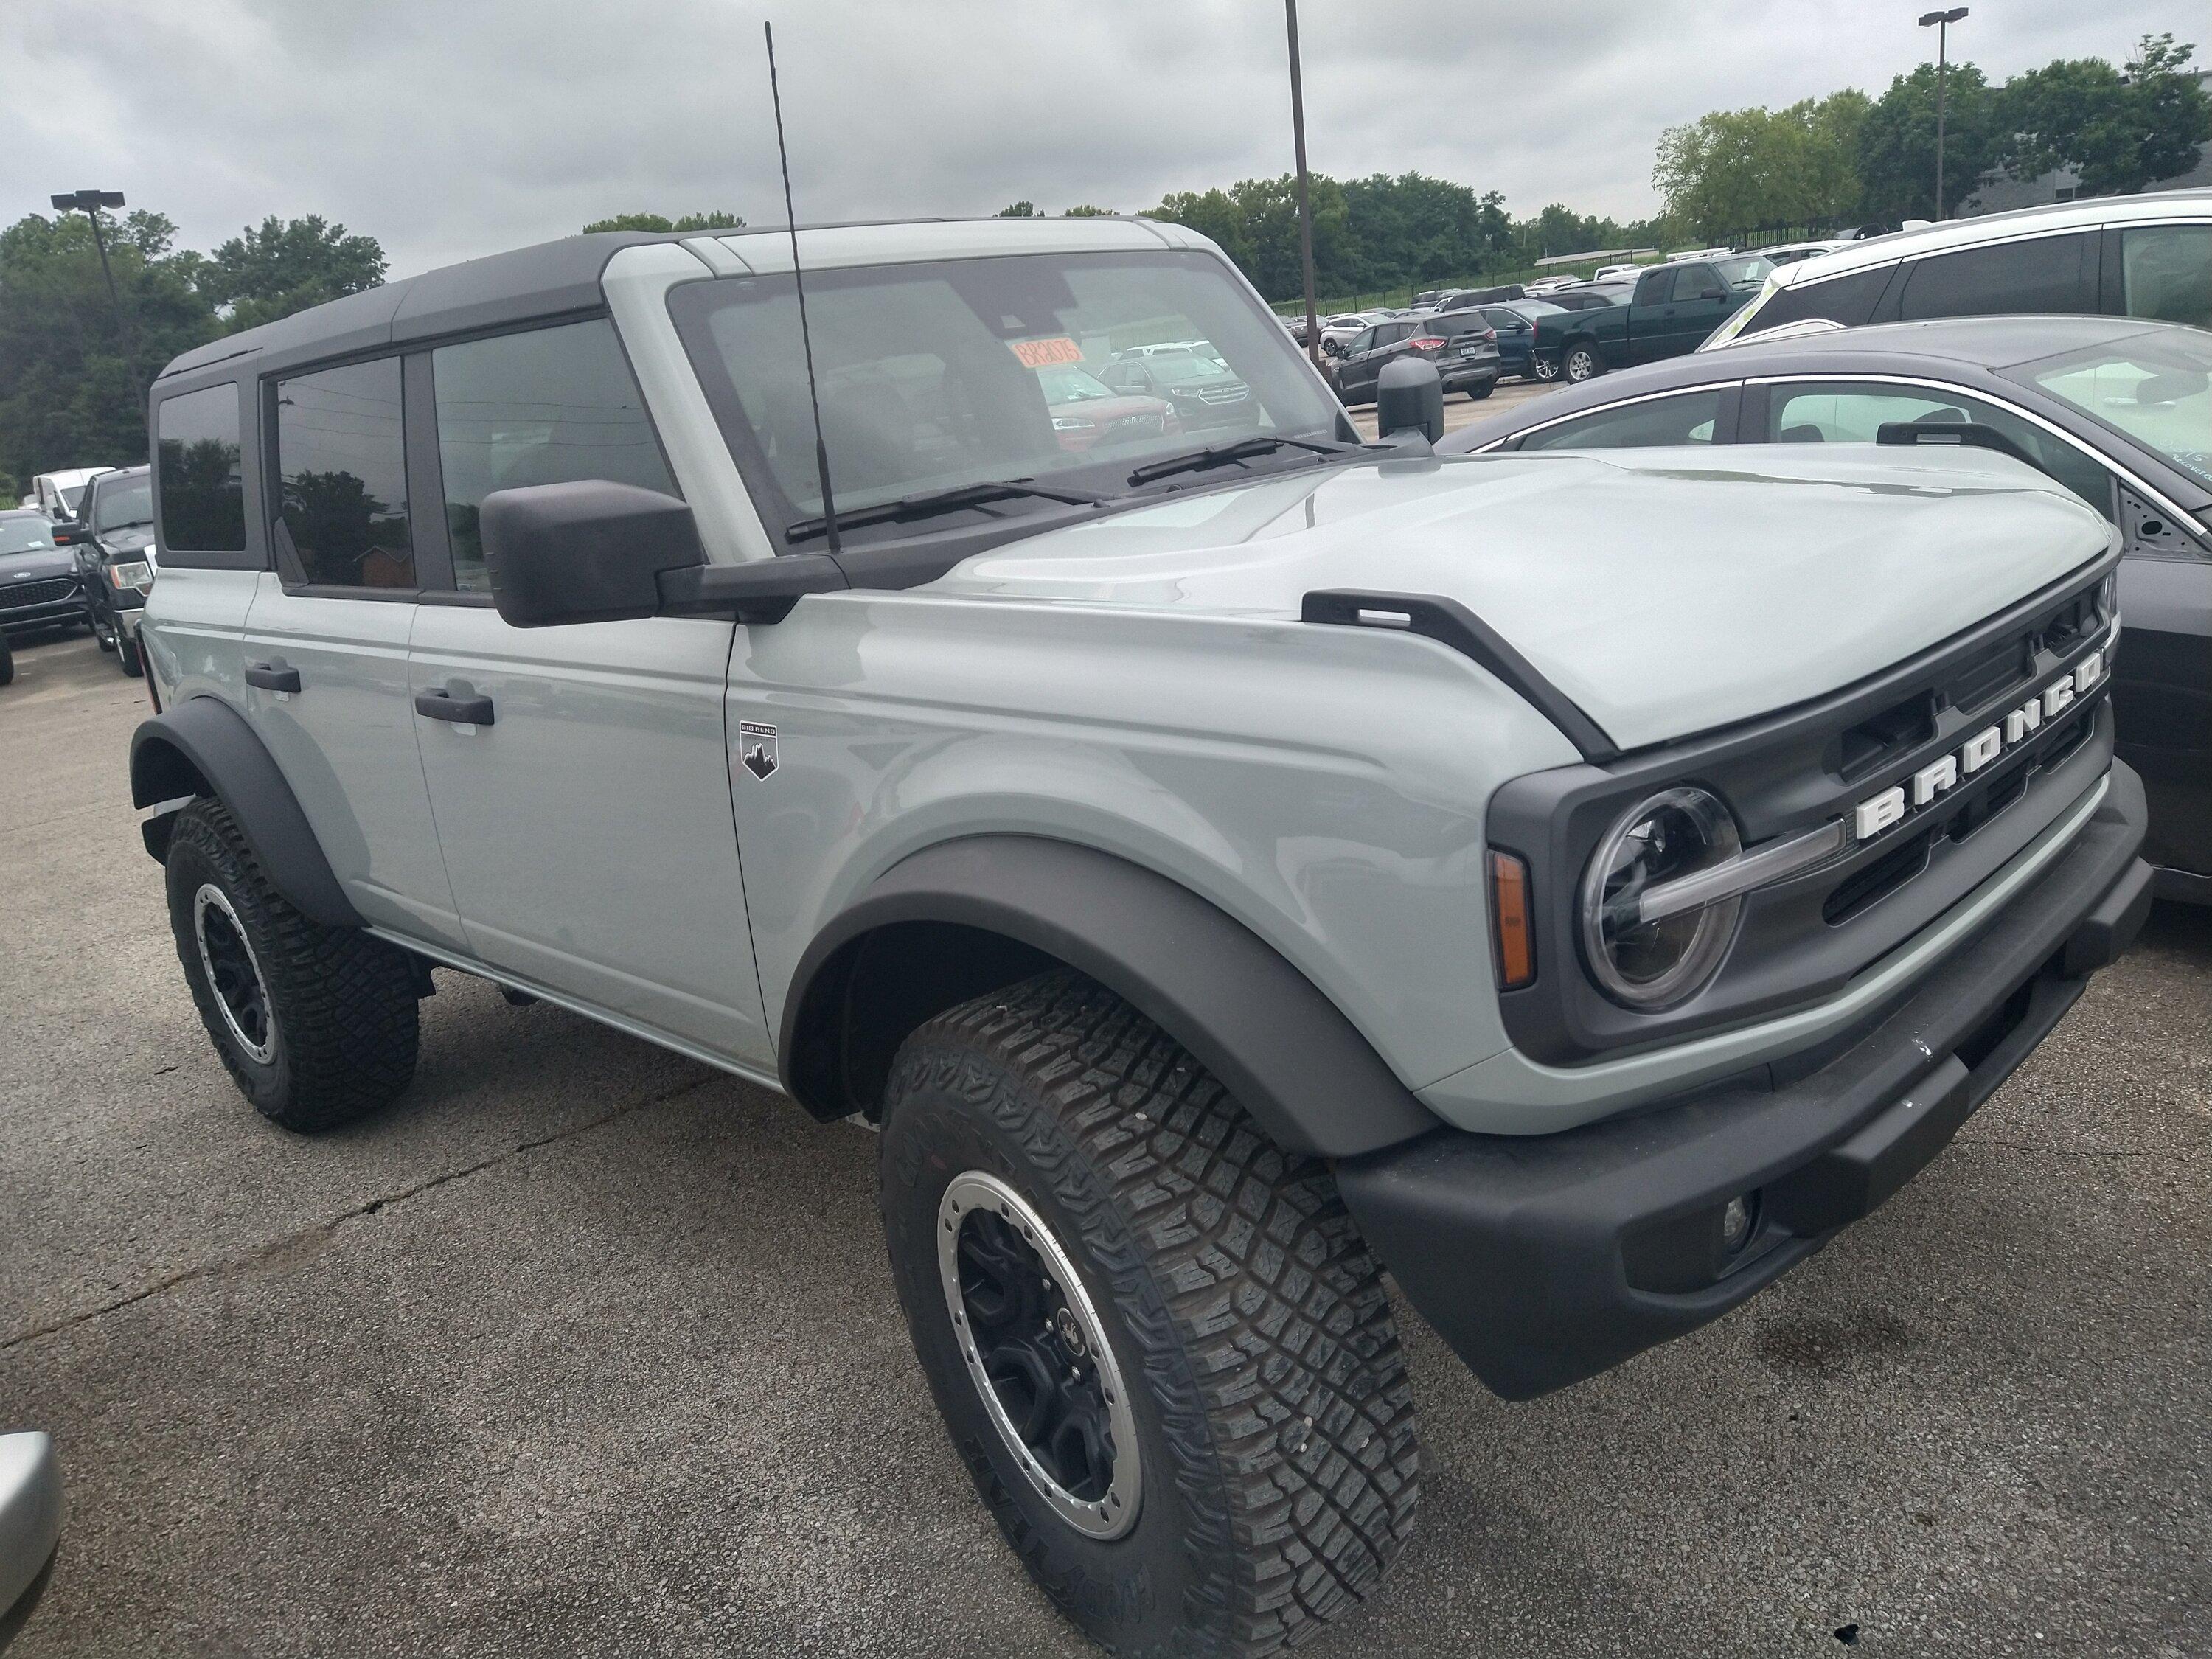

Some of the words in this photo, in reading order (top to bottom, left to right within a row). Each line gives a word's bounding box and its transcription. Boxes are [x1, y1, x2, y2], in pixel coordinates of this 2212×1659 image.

[1015, 338, 1081, 366] BR2075
[755, 726, 776, 734] BEND
[1856, 651, 2101, 840] BRONCO
